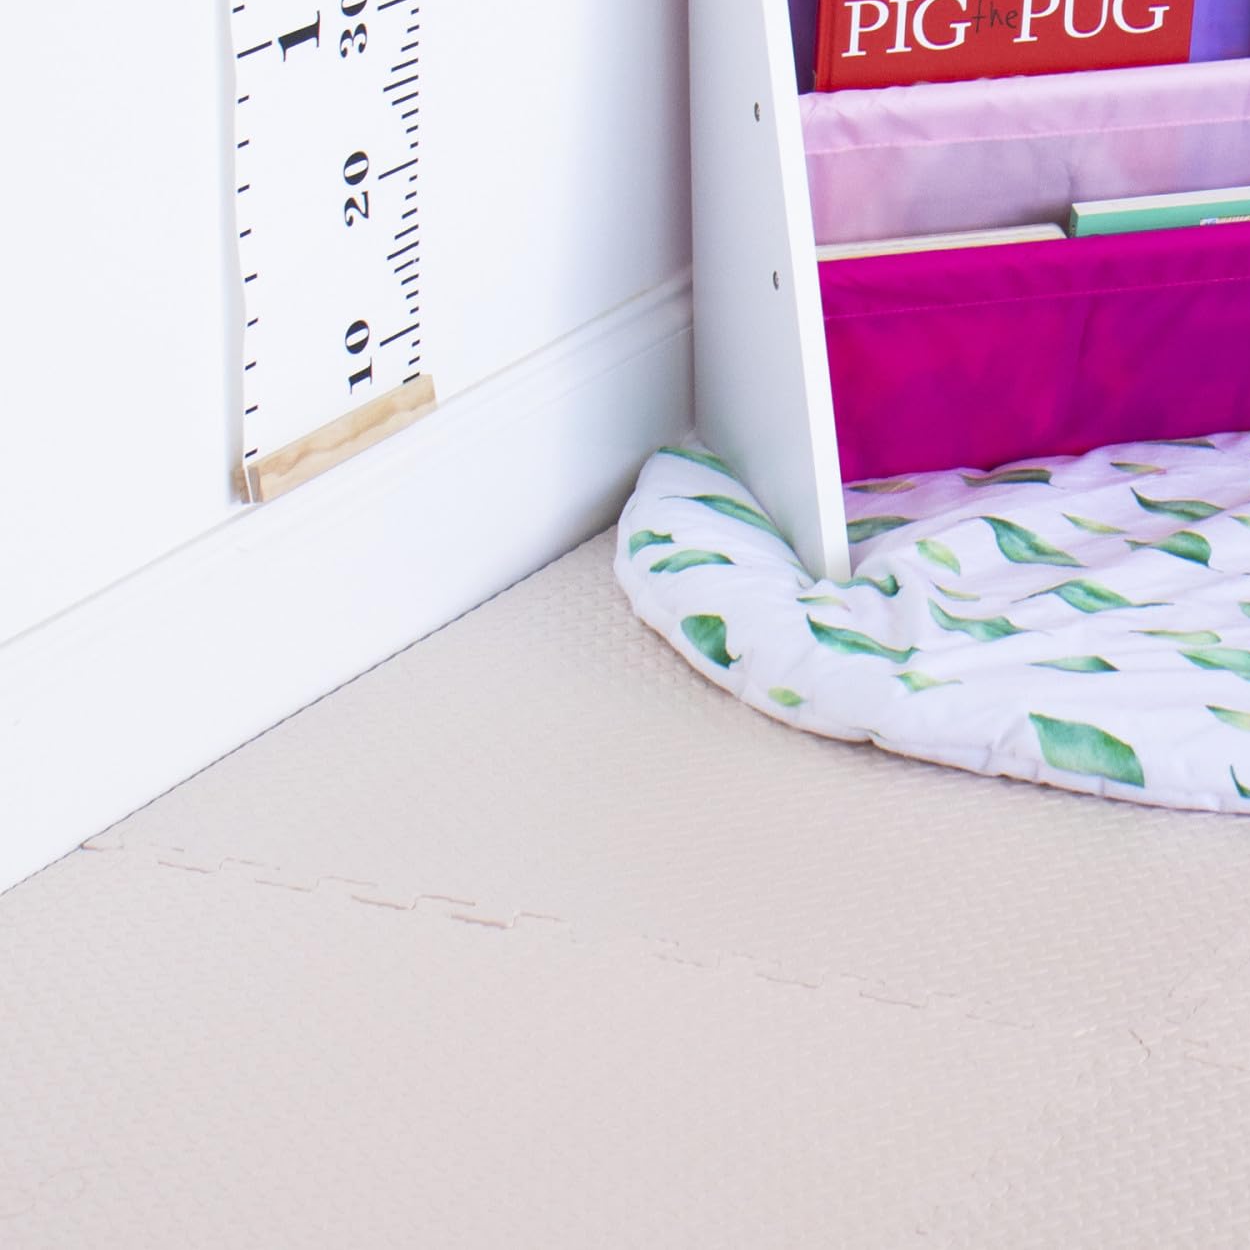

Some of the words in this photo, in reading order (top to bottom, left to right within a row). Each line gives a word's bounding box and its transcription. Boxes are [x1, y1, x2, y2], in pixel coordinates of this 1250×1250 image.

[277, 10, 320, 62] 1
[343, 151, 370, 228] 20
[344, 319, 373, 394] 10
